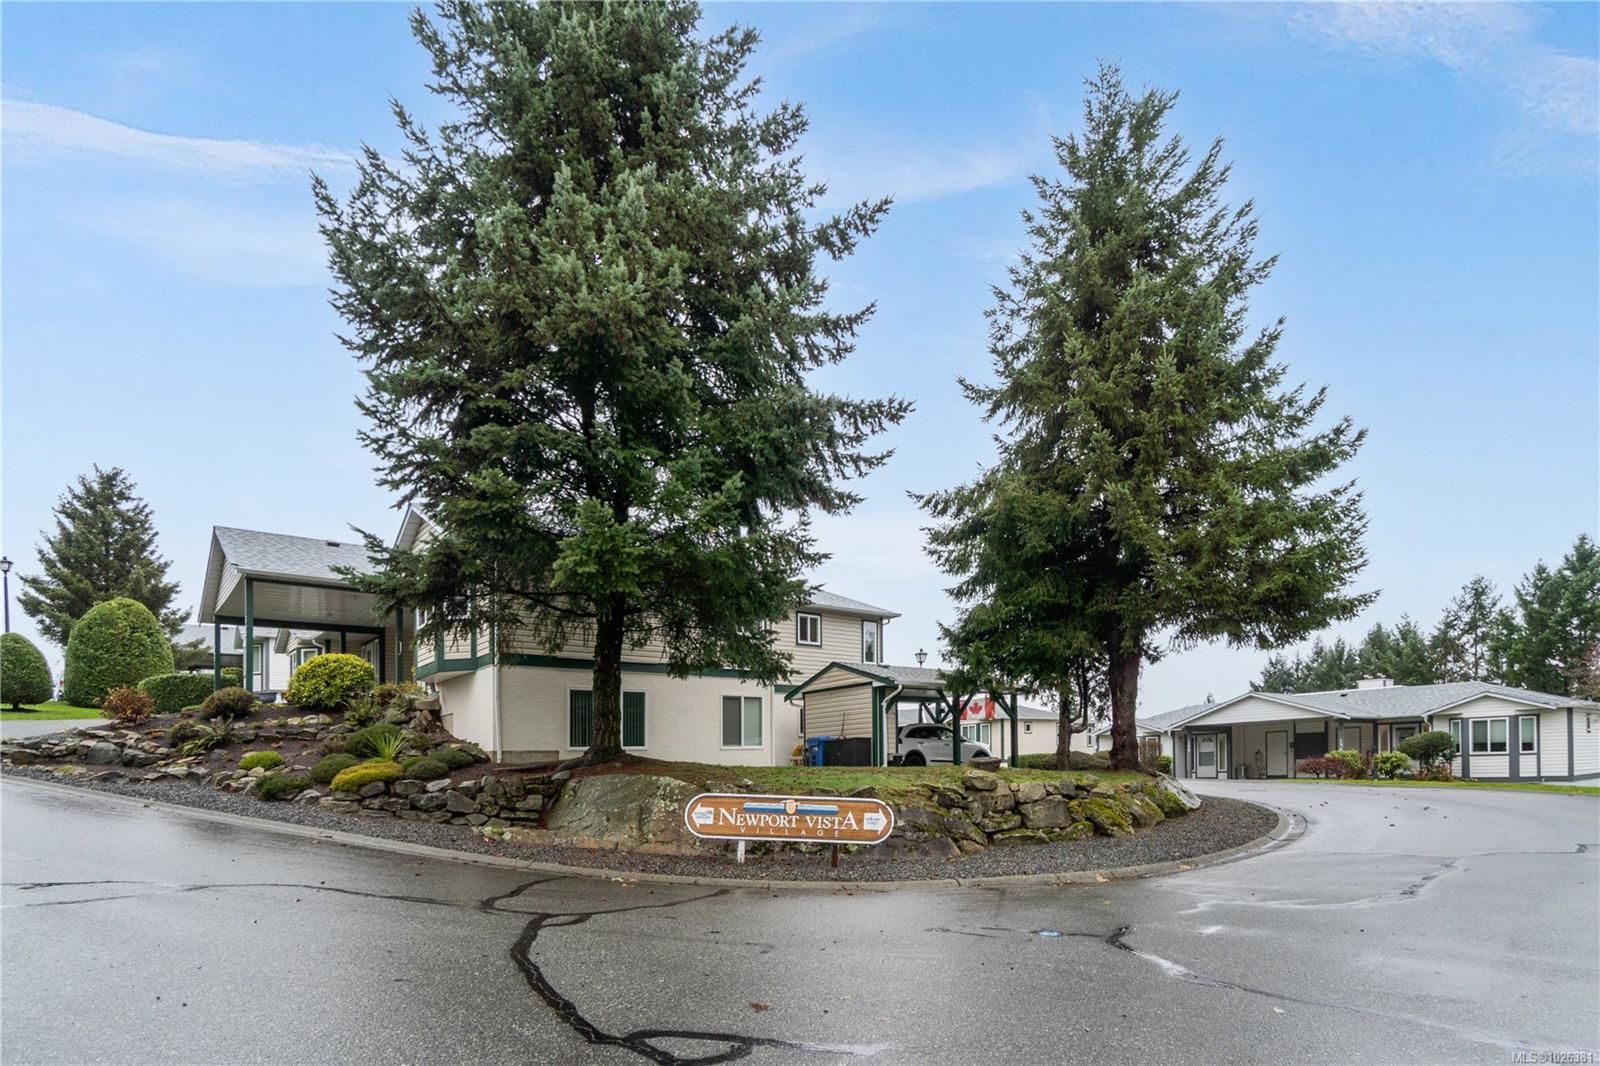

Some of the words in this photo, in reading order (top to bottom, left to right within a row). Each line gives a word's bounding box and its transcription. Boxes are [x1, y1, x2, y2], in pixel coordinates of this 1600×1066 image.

[718, 807, 800, 828] NEWPORT
[805, 811, 860, 831] VISTA
[740, 827, 840, 838] VILLAGE
